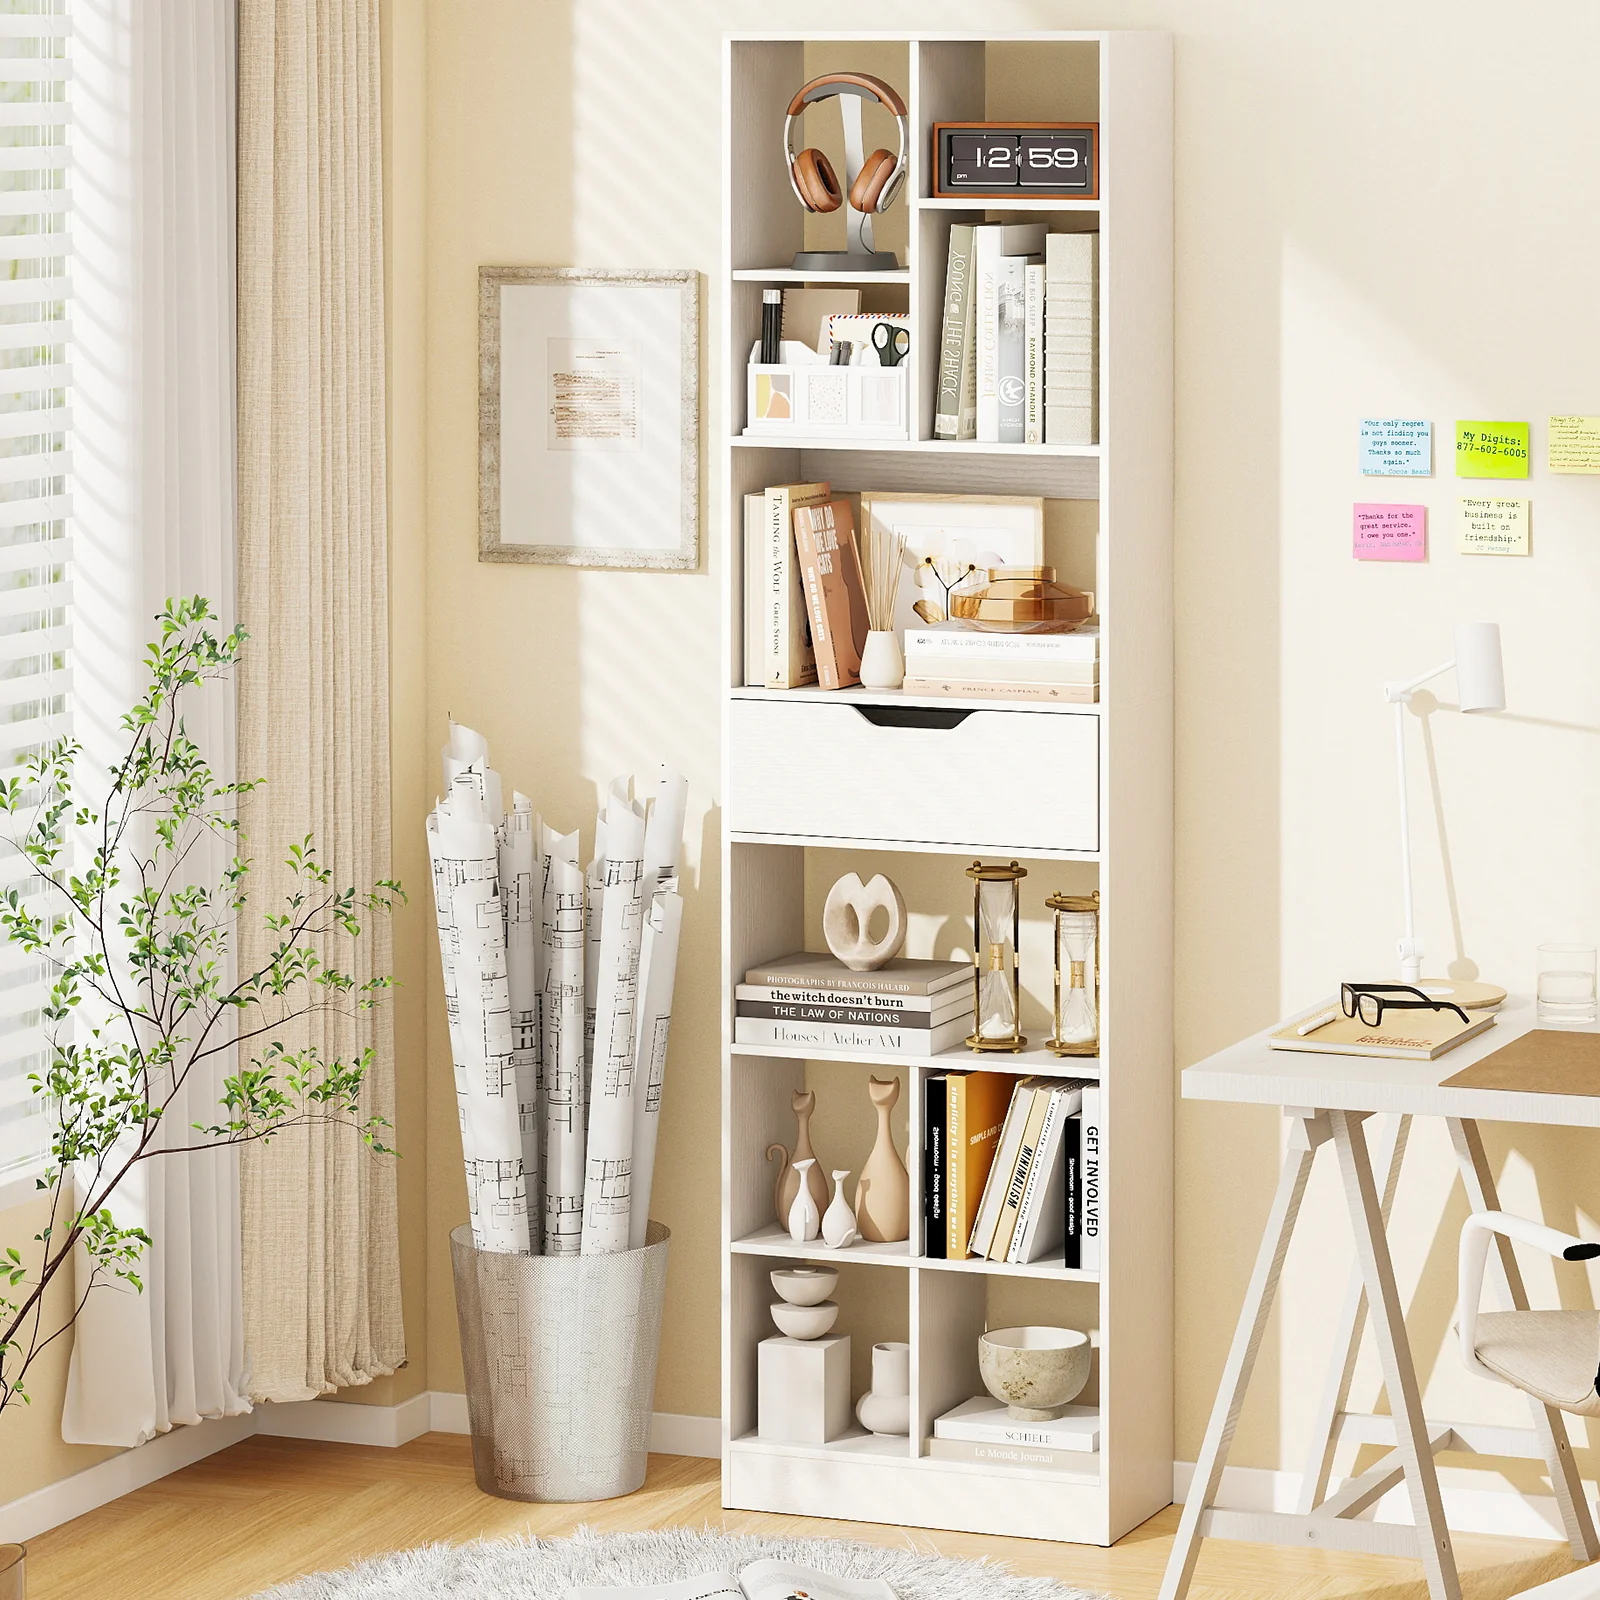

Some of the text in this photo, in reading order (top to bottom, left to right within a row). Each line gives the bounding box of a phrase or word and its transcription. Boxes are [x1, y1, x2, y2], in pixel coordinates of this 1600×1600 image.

[1463, 432, 1520, 446] My Digits:
[1457, 442, 1526, 458] 877-602-6005
[773, 495, 782, 542] TAMING
[767, 976, 825, 986] PHOTOGRAPHS
[877, 983, 910, 992] HALARD
[770, 990, 790, 1000] the
[792, 992, 826, 1002] witch
[875, 996, 903, 1008] burn
[772, 1006, 900, 1023] THE LAW OF NATIONS
[774, 1027, 818, 1042] Houses
[830, 1031, 873, 1046] Atelier
[950, 1087, 958, 1135] simplicity
[952, 1138, 958, 1146] is
[970, 1130, 986, 1146] SIMPLE
[987, 1125, 997, 1138] AND
[952, 1150, 958, 1159] in
[1007, 1144, 1033, 1209] MINIMALISM
[1086, 1126, 1098, 1237] GET INVOLVED
[952, 1217, 956, 1230] we
[1005, 1431, 1052, 1443] SCHIELE
[975, 1448, 1053, 1463] Le Monde Journal
